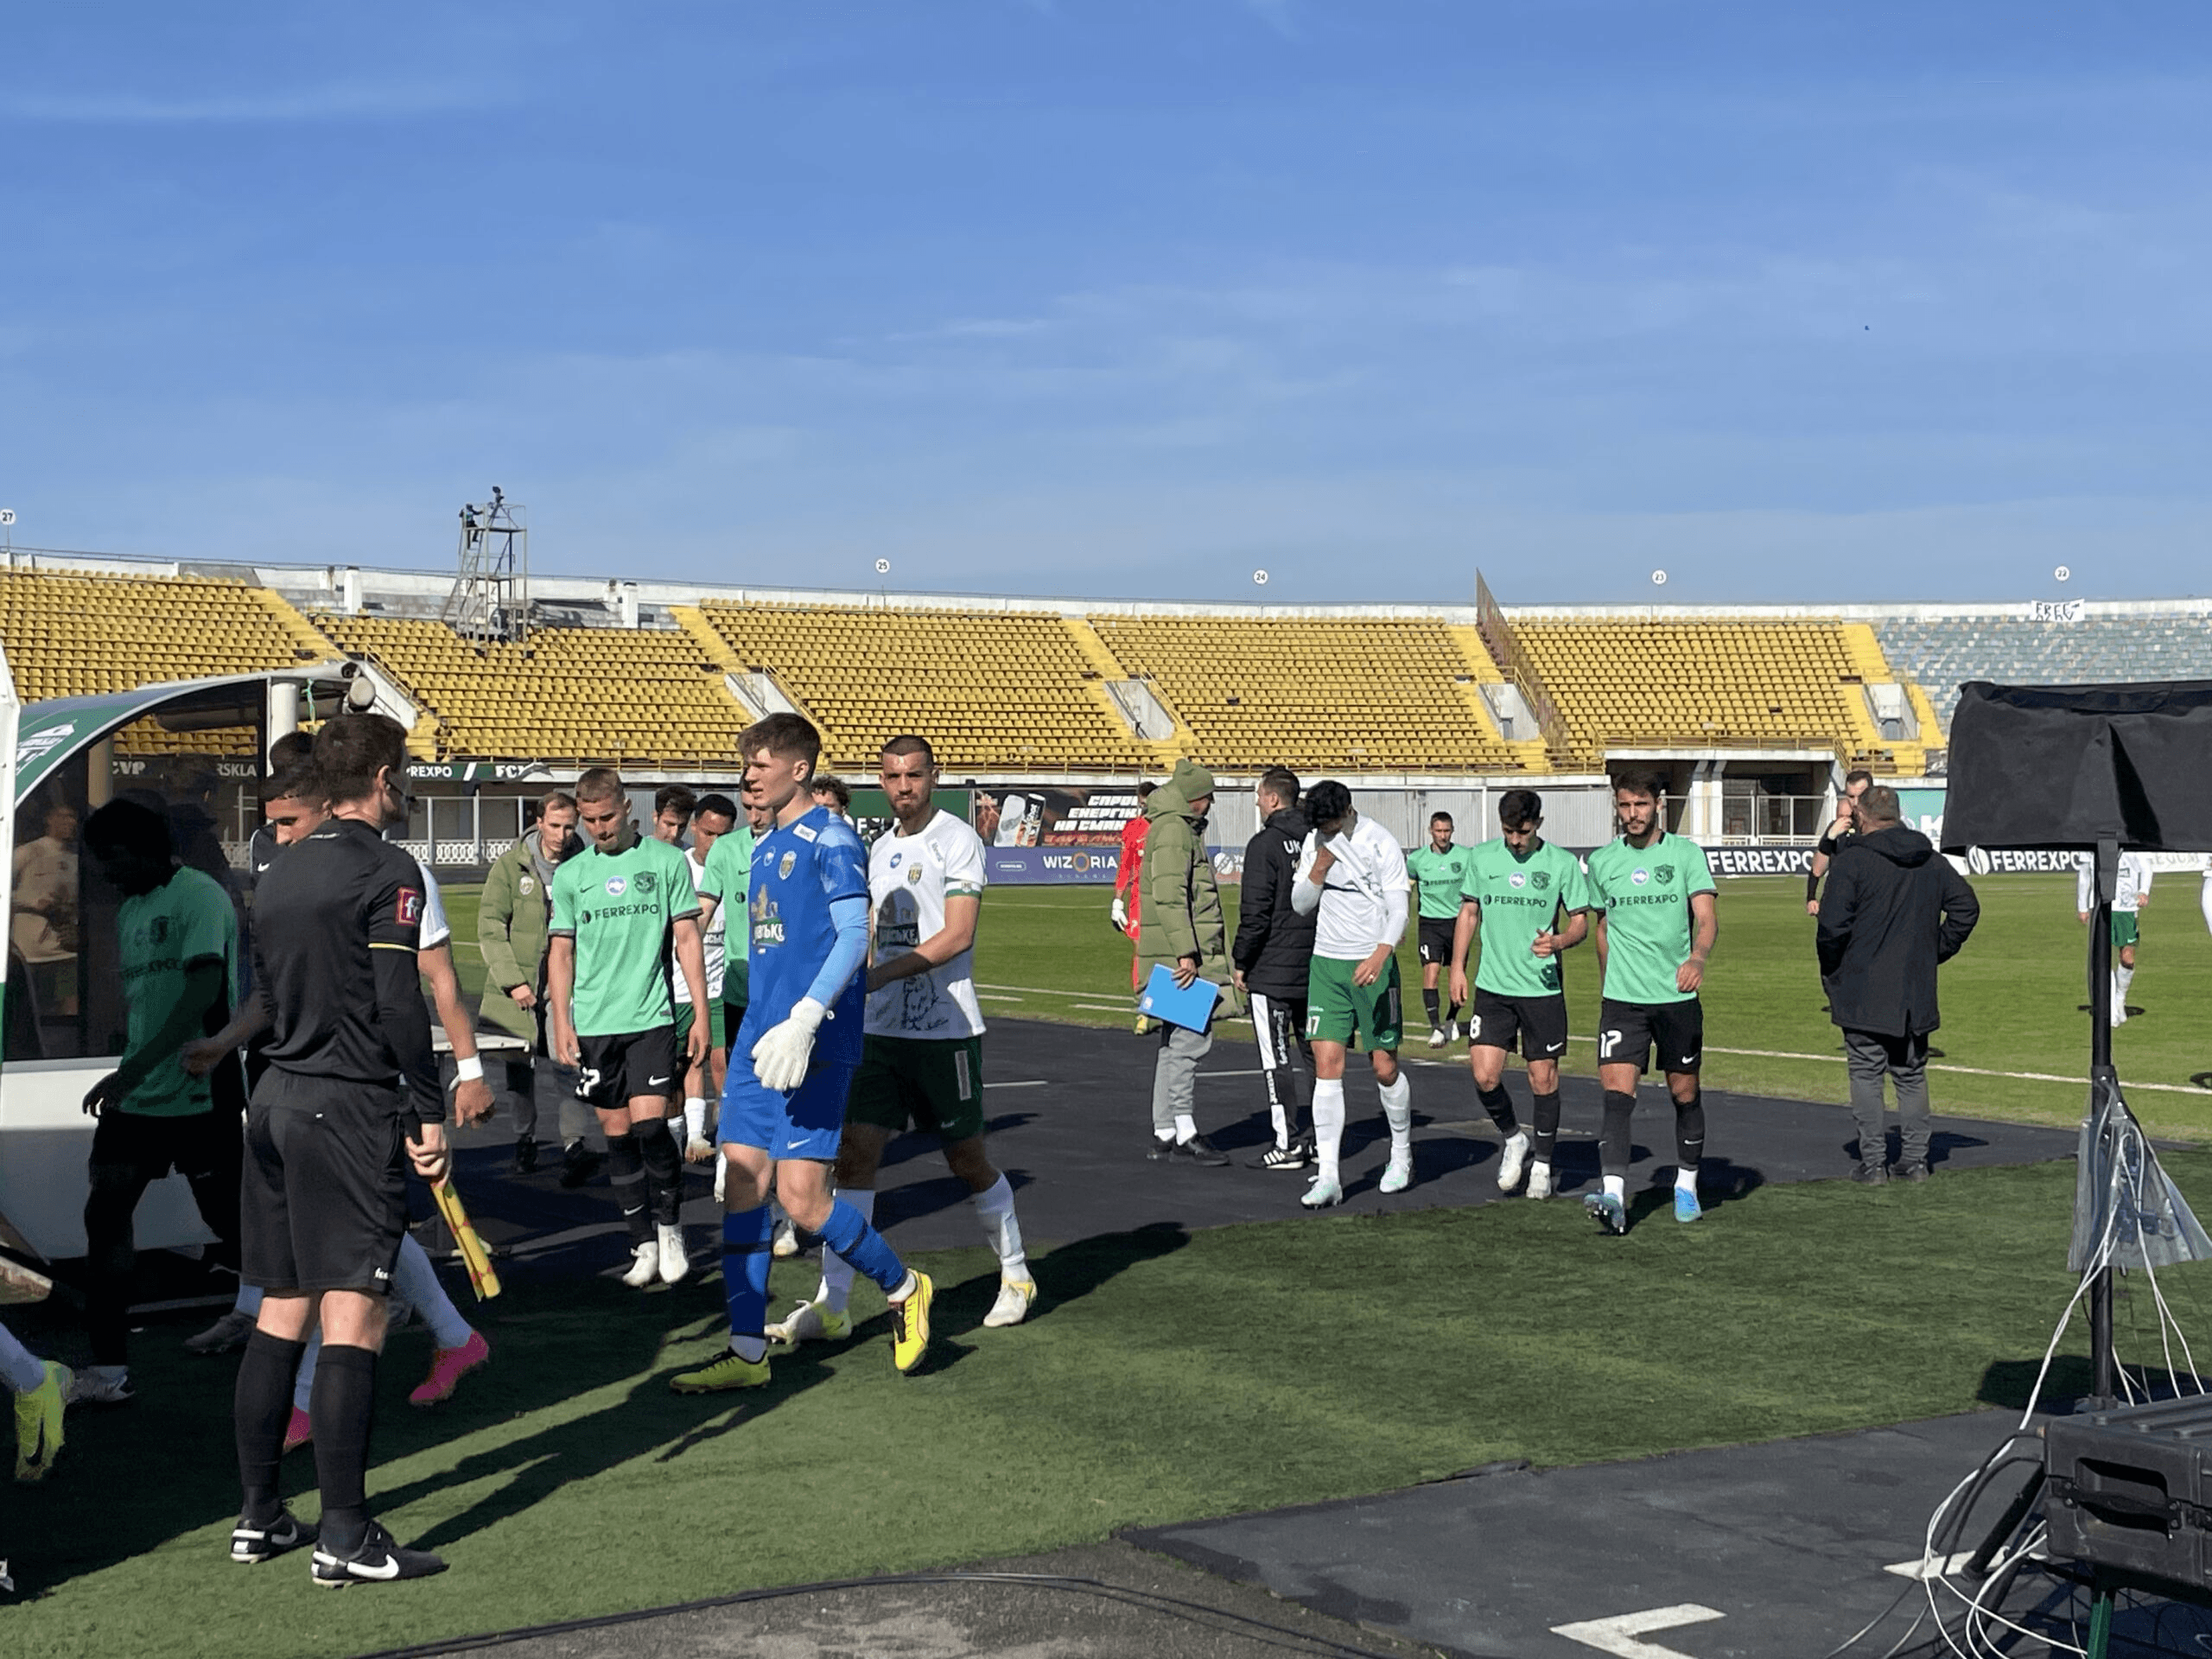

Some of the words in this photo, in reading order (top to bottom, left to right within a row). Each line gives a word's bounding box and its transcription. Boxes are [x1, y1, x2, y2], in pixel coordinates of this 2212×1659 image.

[2, 512, 14, 522] 27
[878, 561, 888, 570] 25
[1255, 572, 1266, 581] 24
[1042, 852, 1119, 872] WIZORIA
[1494, 895, 1548, 908] FERREXPO
[1618, 893, 1679, 906] FERREXPO
[594, 904, 659, 920] FERREXPO
[1420, 944, 1430, 960] 4
[1600, 1030, 1622, 1058] 17
